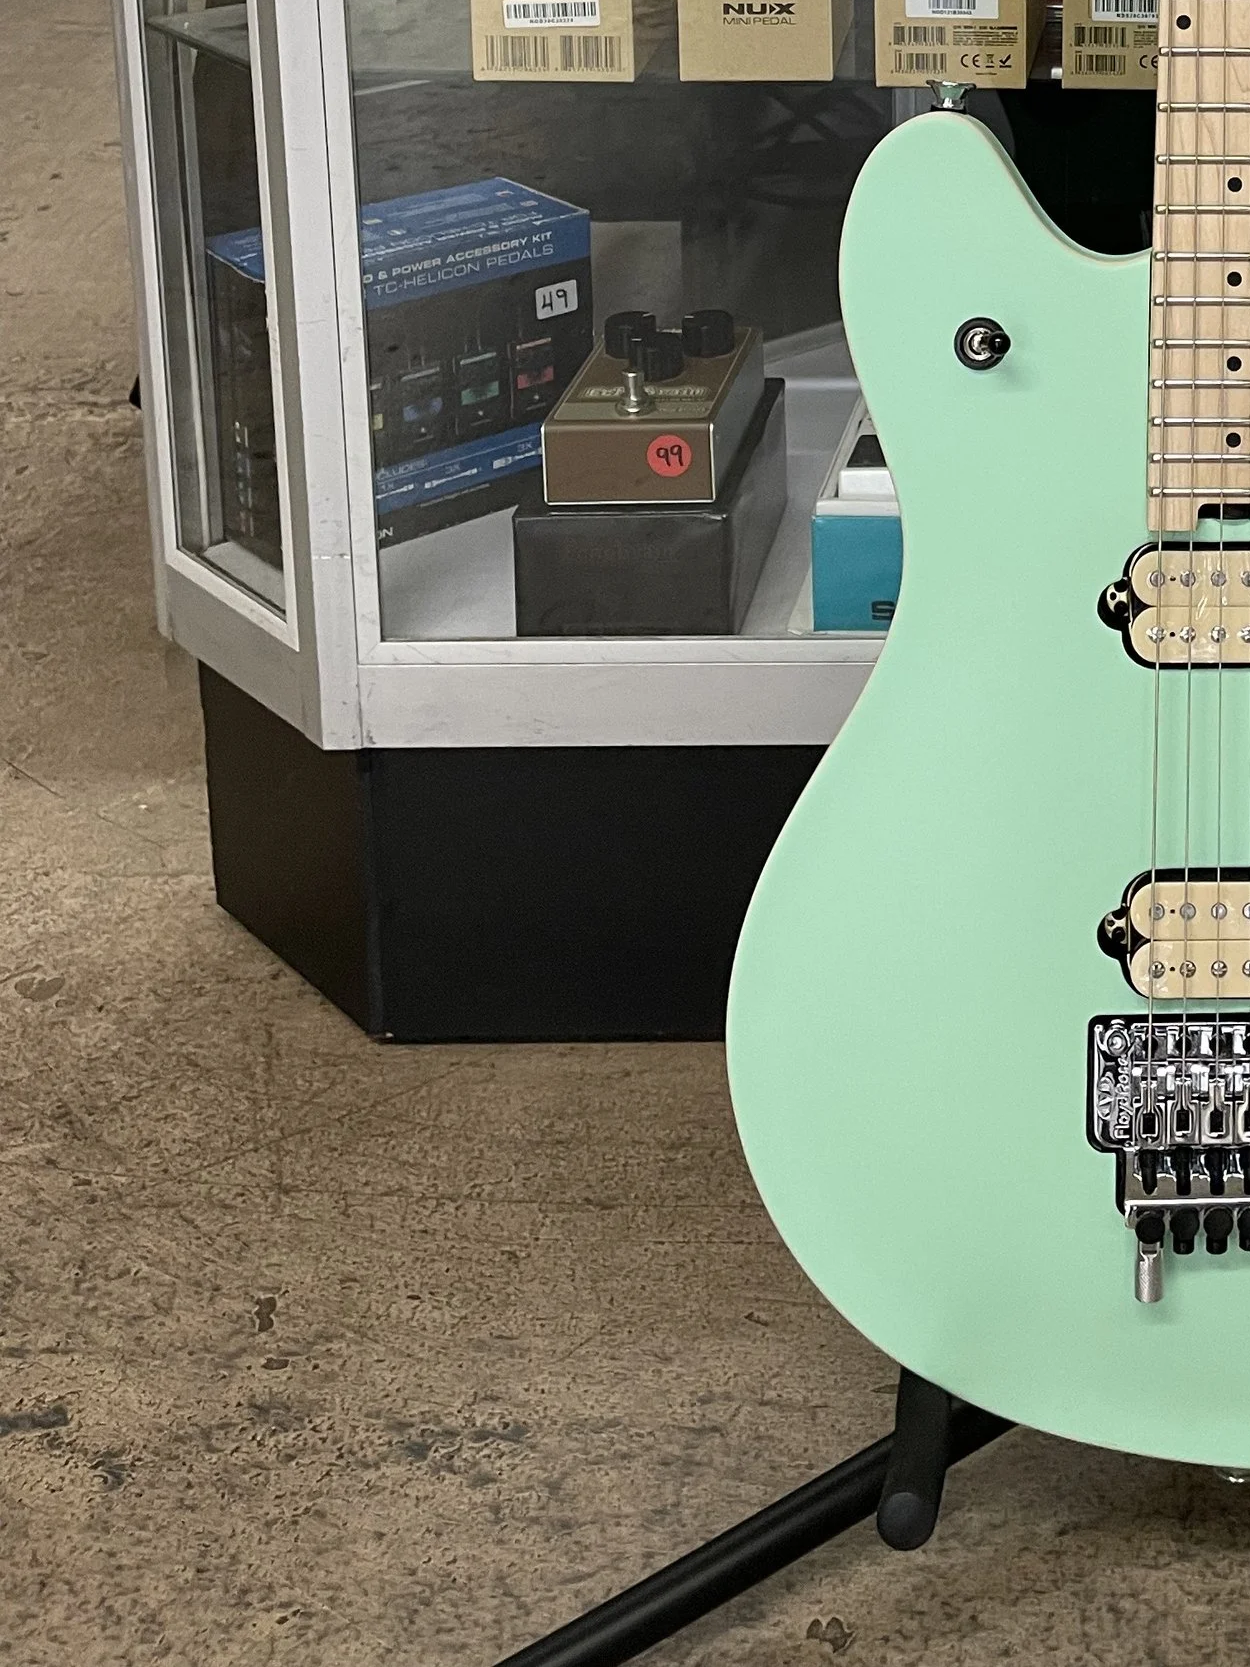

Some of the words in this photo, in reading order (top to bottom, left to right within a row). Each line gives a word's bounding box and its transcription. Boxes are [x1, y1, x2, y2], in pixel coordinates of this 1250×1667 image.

[722, 2, 796, 15] NUX
[722, 16, 752, 26] MINI
[753, 16, 796, 26] PEDAL
[392, 257, 442, 278] POWER
[446, 235, 529, 264] ACCESSORY
[531, 230, 553, 245] KIT
[372, 259, 481, 298] TC-HELICON
[485, 242, 555, 269] PEDALS
[541, 288, 569, 313] 49
[656, 444, 684, 467] 99
